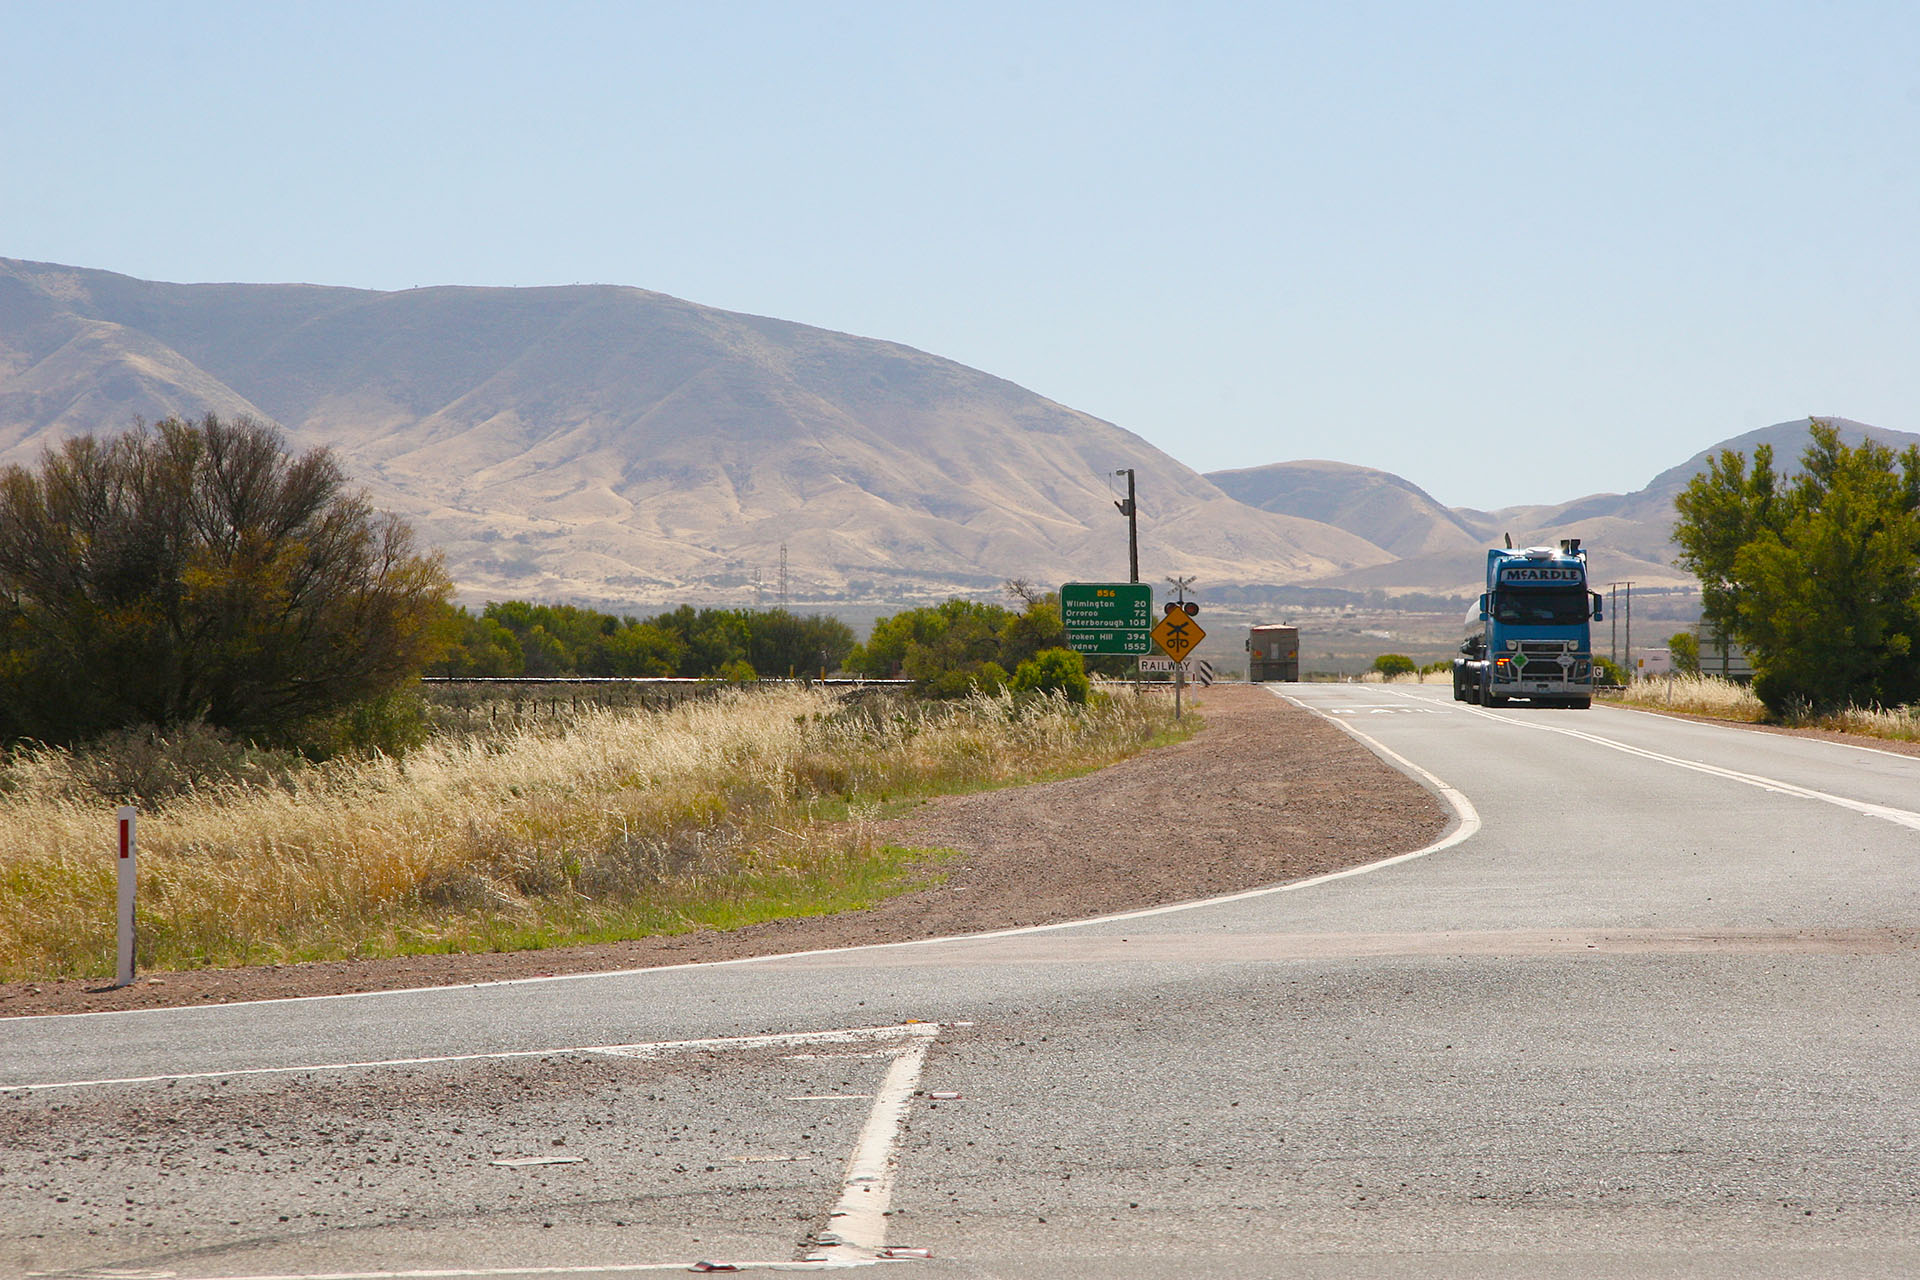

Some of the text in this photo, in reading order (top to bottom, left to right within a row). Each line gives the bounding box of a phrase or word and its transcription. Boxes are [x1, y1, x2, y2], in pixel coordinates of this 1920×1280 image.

[1066, 600, 1147, 609] Wilmington 20
[1066, 619, 1124, 628] Peterborough
